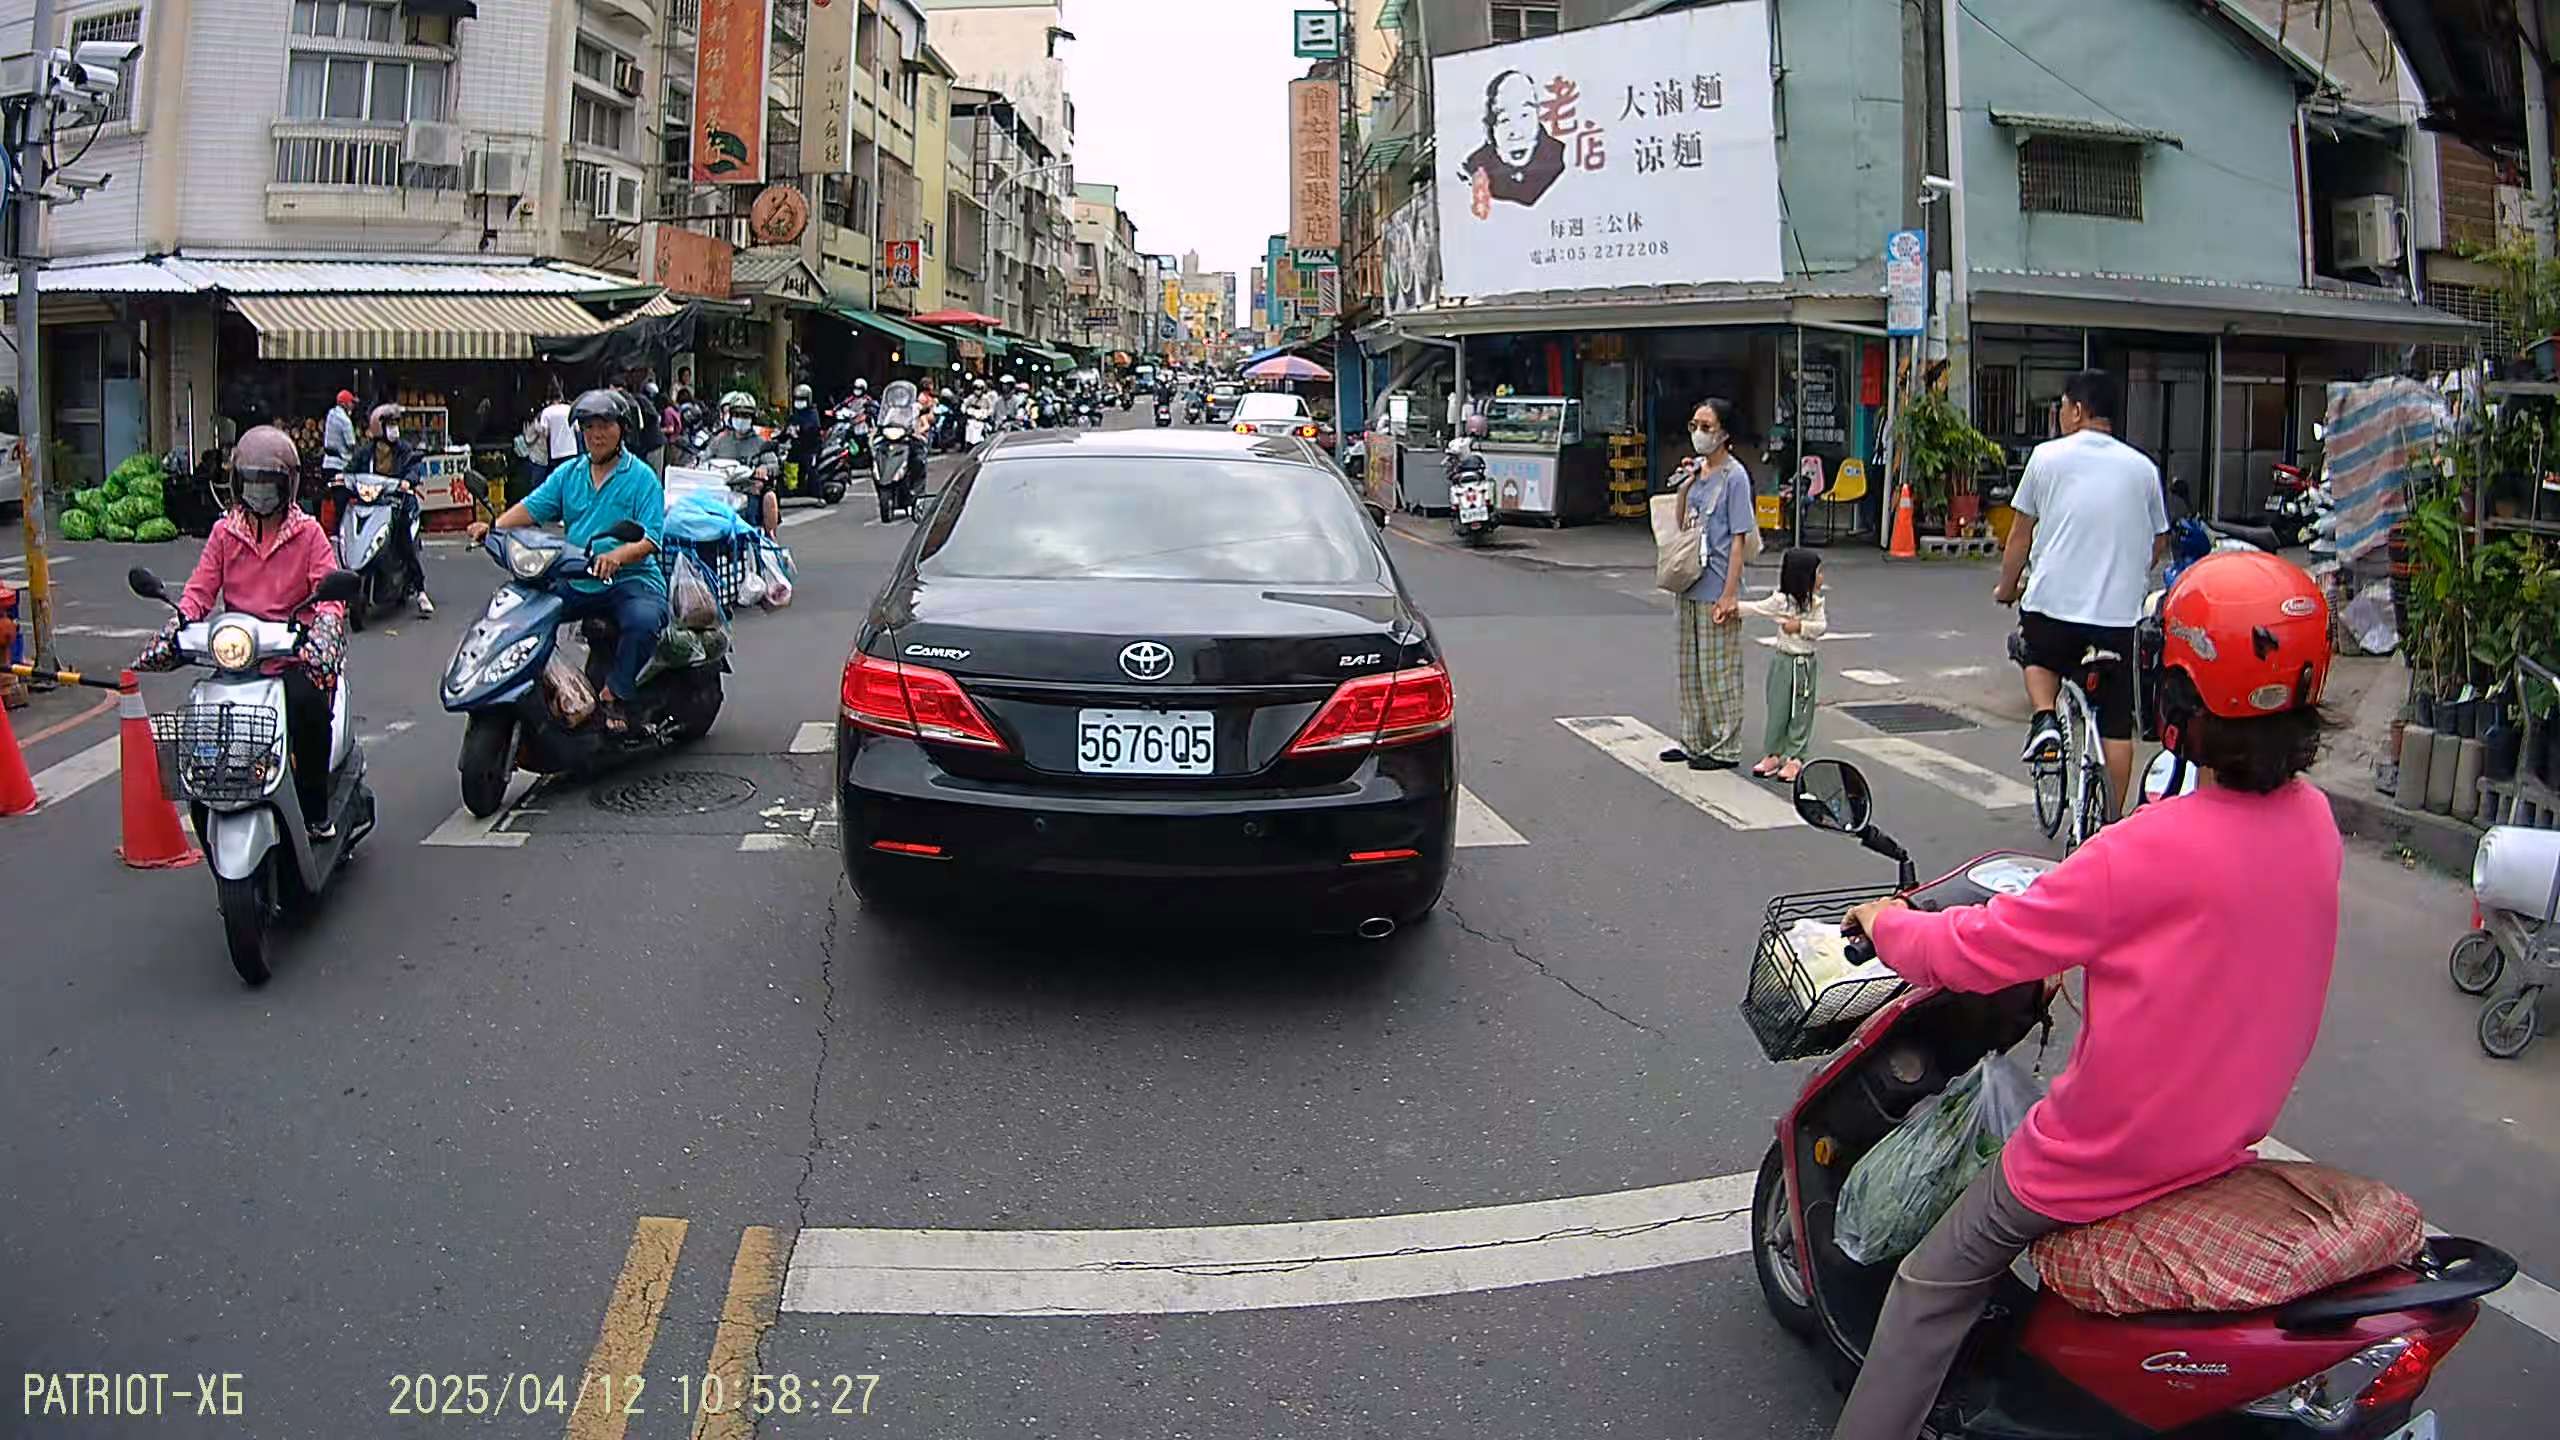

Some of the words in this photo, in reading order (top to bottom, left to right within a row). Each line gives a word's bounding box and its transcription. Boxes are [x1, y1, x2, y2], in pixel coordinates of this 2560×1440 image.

[1539, 76, 1606, 170] 老店
[1634, 131, 1703, 174] 涼麵
[905, 644, 971, 661] CAMRY
[1080, 723, 1212, 764] 5676-Q5
